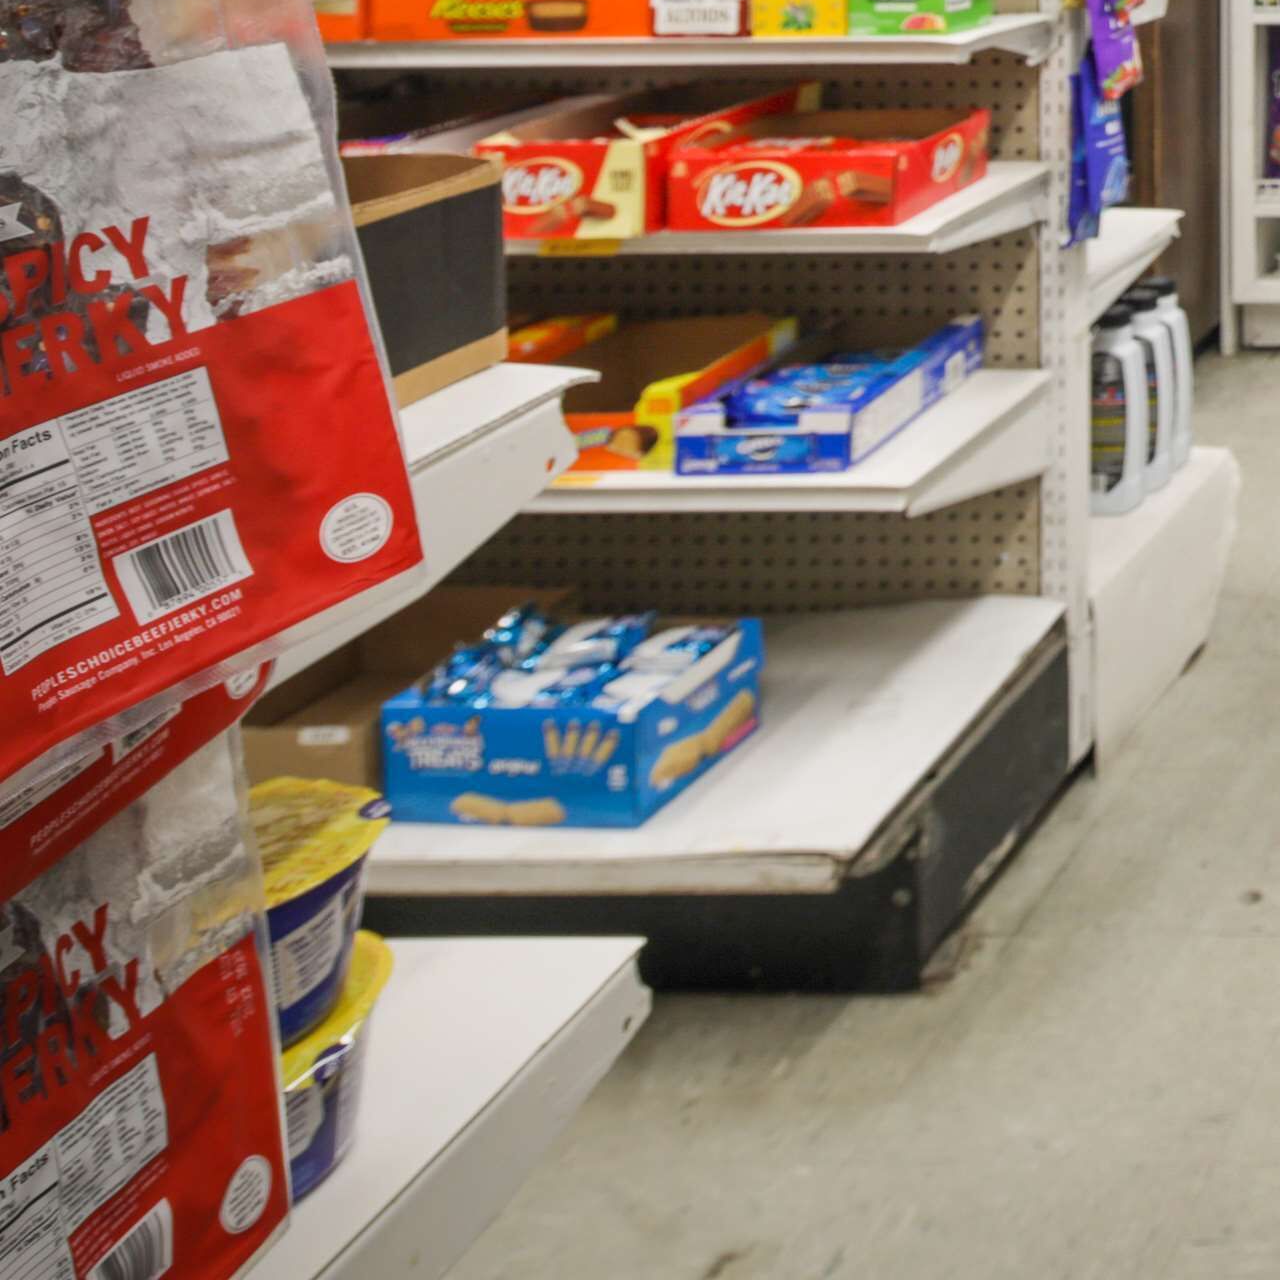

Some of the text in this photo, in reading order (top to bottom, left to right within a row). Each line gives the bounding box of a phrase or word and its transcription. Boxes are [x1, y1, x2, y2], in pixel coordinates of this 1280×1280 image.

[0, 216, 150, 322] PICY
[0, 275, 188, 382] ERKY
[146, 356, 174, 373] SMOKE
[11, 429, 53, 455] Facts
[31, 588, 244, 701] PEOPLESCHOICEBEEFJERKY.COM
[57, 676, 98, 702] Sausage
[97, 656, 142, 682] Company,
[158, 639, 174, 652] Los
[173, 624, 206, 645] Angeles,
[204, 617, 218, 629] CA
[2, 901, 109, 1048] PICY
[0, 957, 142, 1105] ERKY
